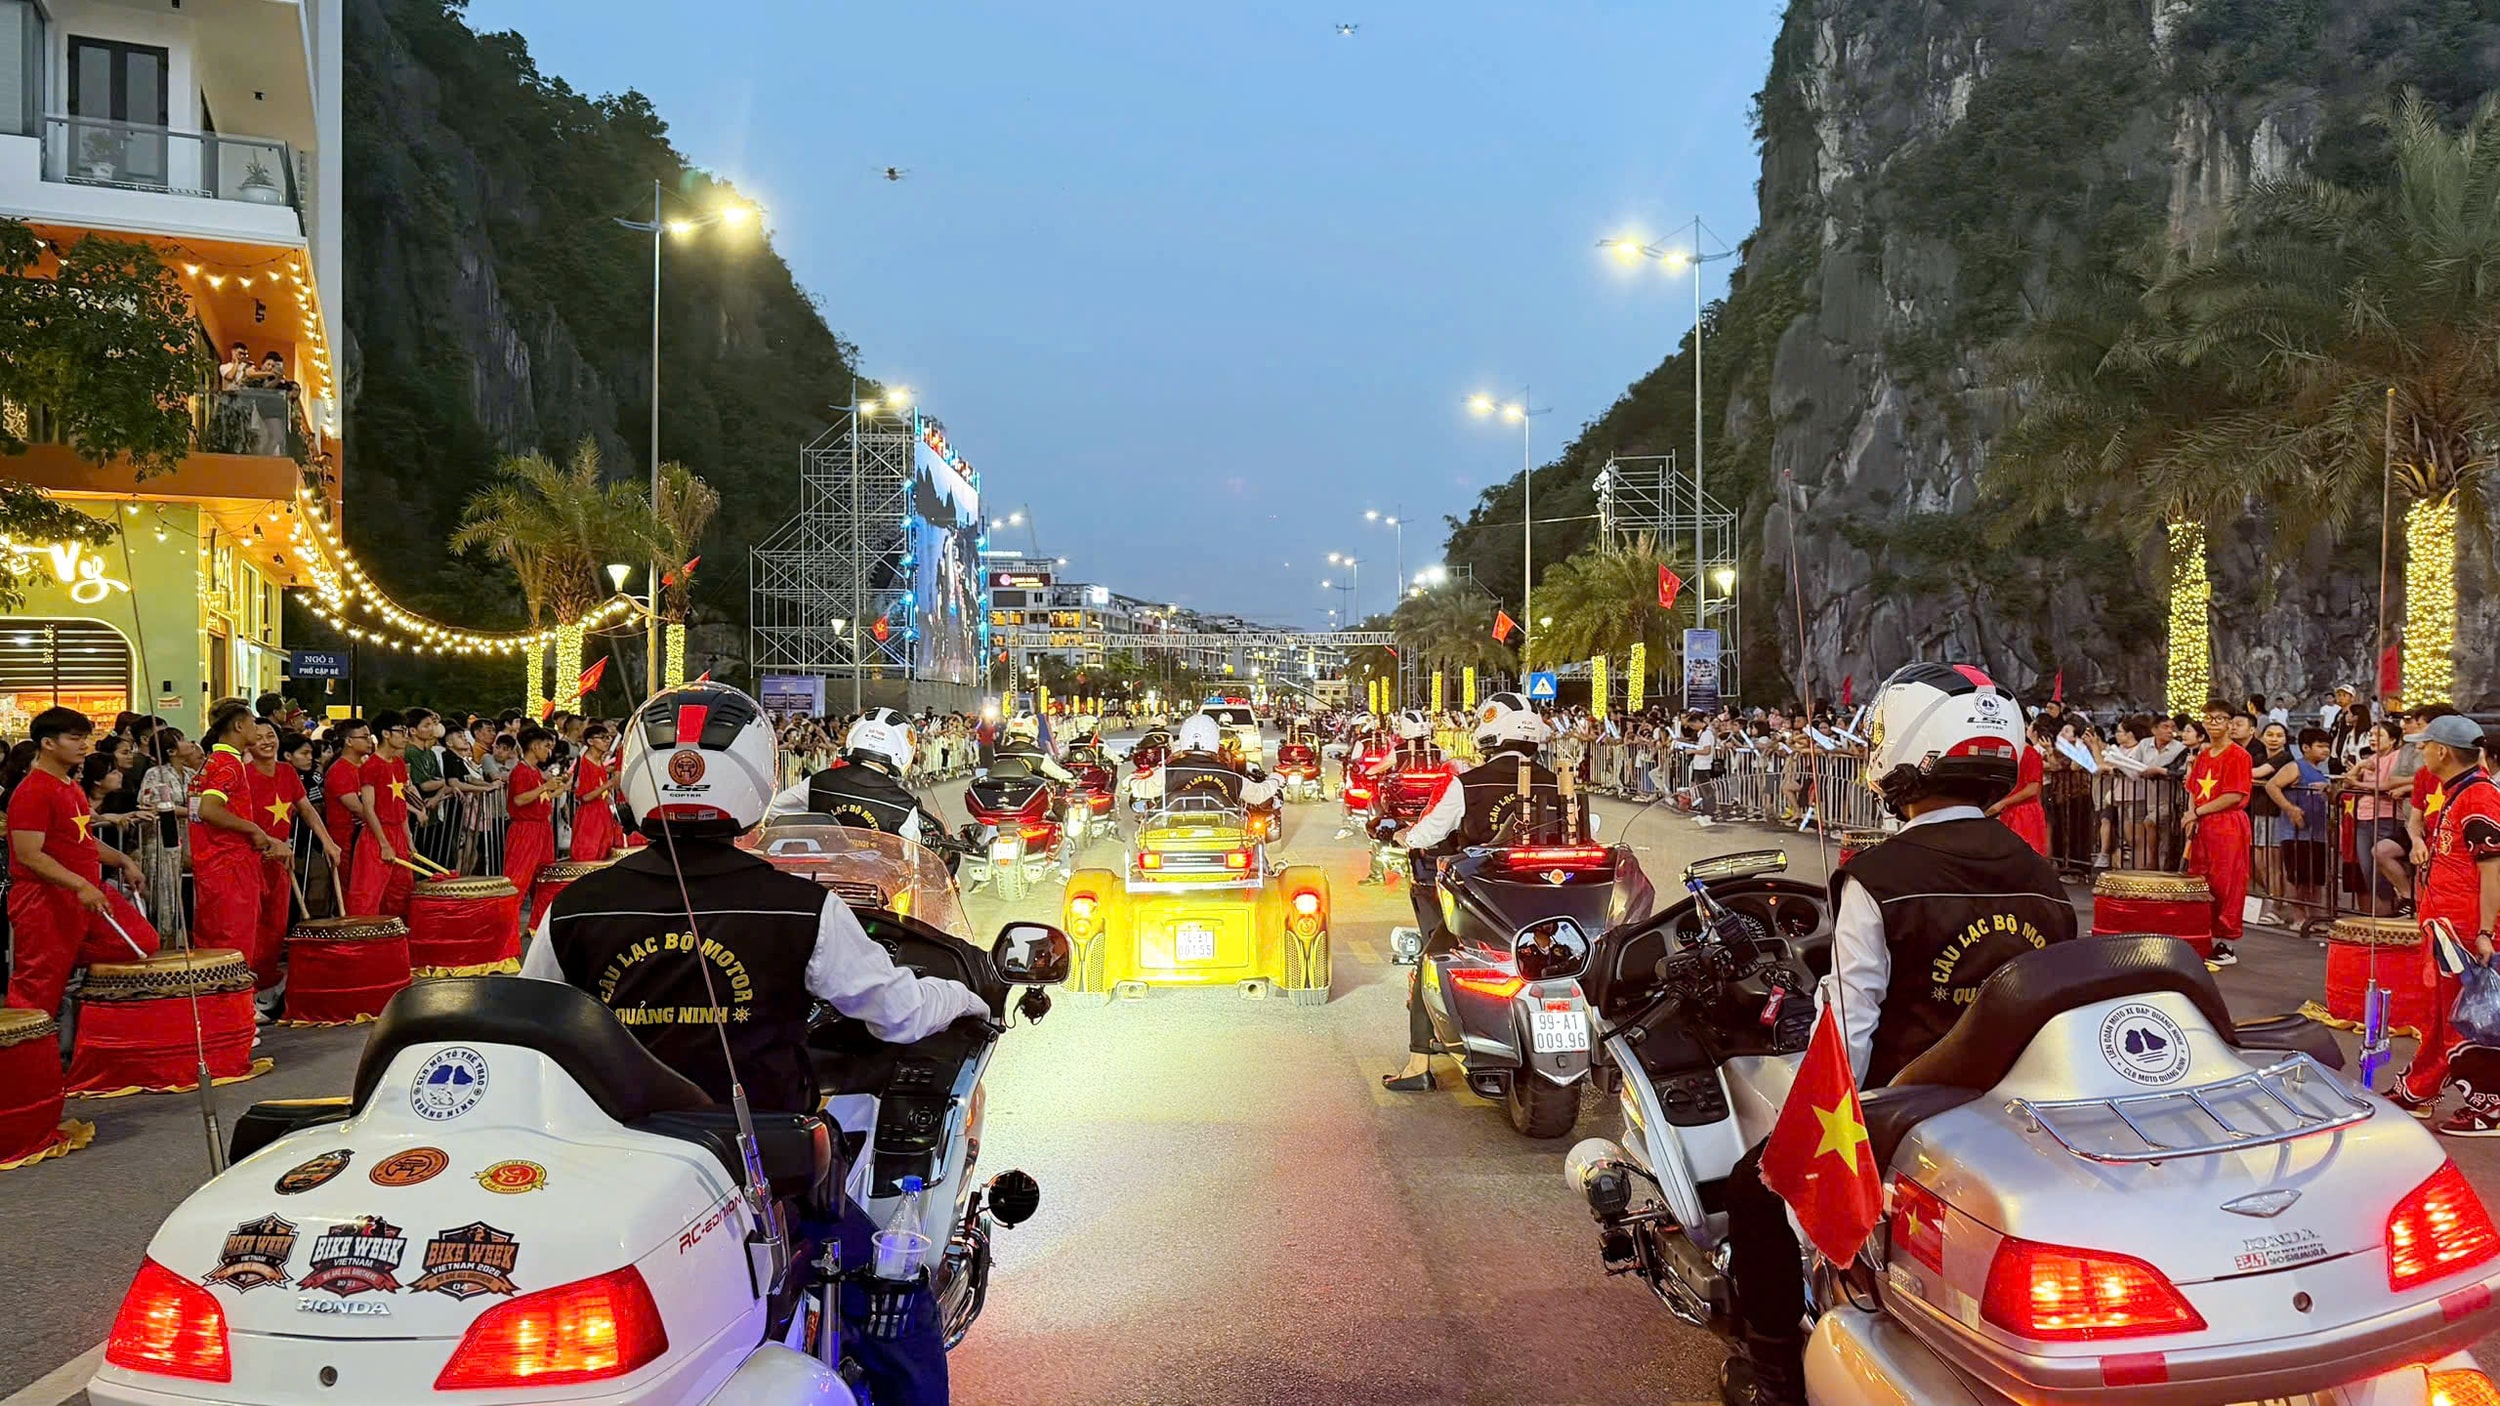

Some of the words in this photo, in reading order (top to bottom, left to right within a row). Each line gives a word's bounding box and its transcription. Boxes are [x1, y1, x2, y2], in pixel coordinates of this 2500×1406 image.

[328, 656, 334, 664] 3
[661, 784, 711, 792] LS2
[1958, 918, 1990, 948] LẠC
[1992, 914, 2018, 935] BỘ
[616, 937, 658, 968] LẠC
[664, 930, 695, 954] BỘ
[700, 938, 754, 1003] MOTOR
[614, 1000, 674, 1025] QUẢNG
[678, 1007, 728, 1024] NINH
[1539, 1014, 1578, 1030] 99-A1
[1537, 1032, 1586, 1049] 009.96
[416, 1069, 429, 1086] CLB
[475, 1063, 485, 1086] THAO
[2123, 1067, 2137, 1078] CLB
[2138, 1074, 2158, 1083] MOTO
[447, 1098, 475, 1117] NINH
[224, 1235, 257, 1256] BIKE
[254, 1235, 295, 1260] WEEK
[2243, 1229, 2320, 1251] HONDA
[312, 1236, 354, 1263] BIKE
[354, 1236, 404, 1266] WEEK
[426, 1243, 467, 1266] BIKE
[468, 1244, 516, 1270] WEEK
[2269, 1248, 2328, 1265] YOSHIMURA
[334, 1257, 374, 1268] VIETNAM
[431, 1262, 474, 1274] VIETNAM
[342, 1267, 351, 1275] ALL
[352, 1268, 378, 1281] BROTHERS
[297, 1297, 390, 1315] HONDA
